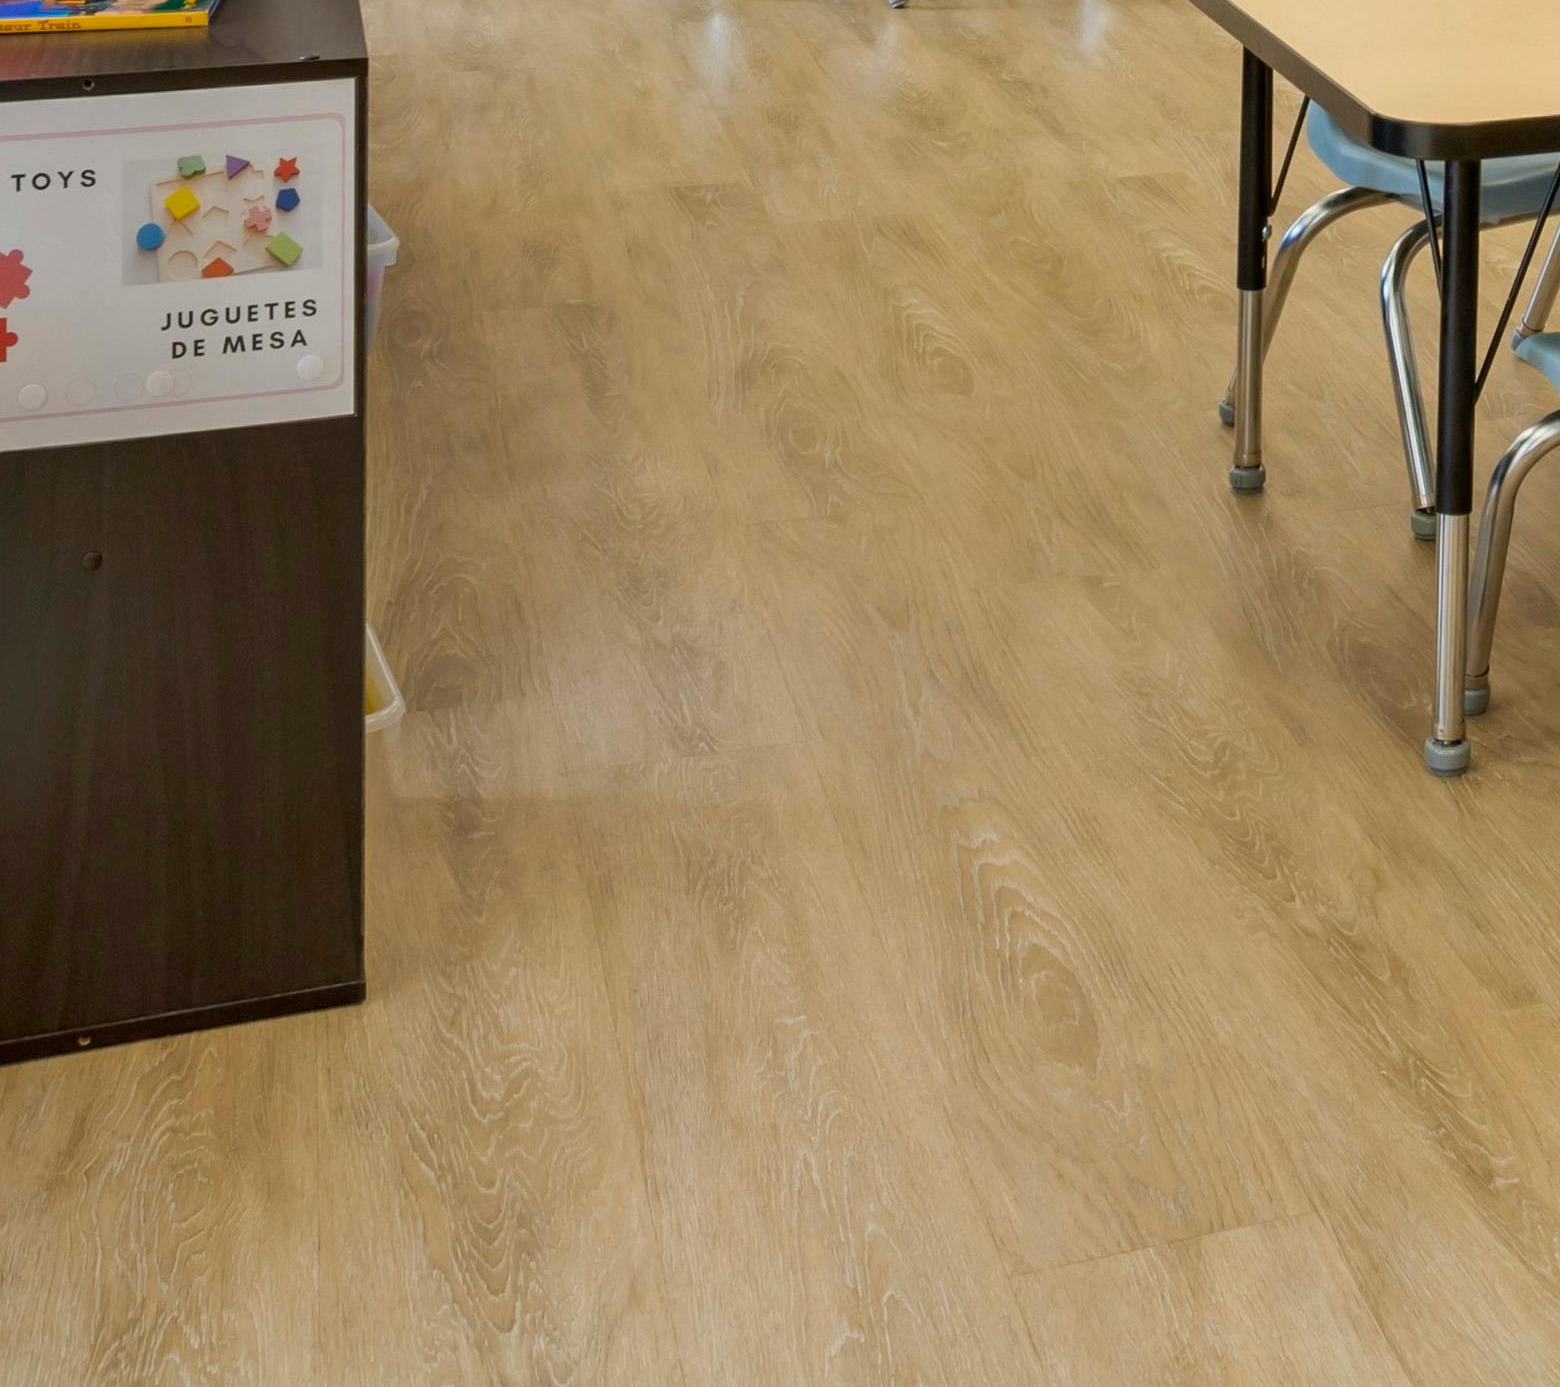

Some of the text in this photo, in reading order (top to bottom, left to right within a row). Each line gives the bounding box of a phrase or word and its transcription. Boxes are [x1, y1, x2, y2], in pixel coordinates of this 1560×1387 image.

[37, 20, 83, 31] Train
[11, 169, 97, 193] TOYS
[161, 299, 318, 331] JUGUETES
[172, 329, 308, 359] DE MESA
